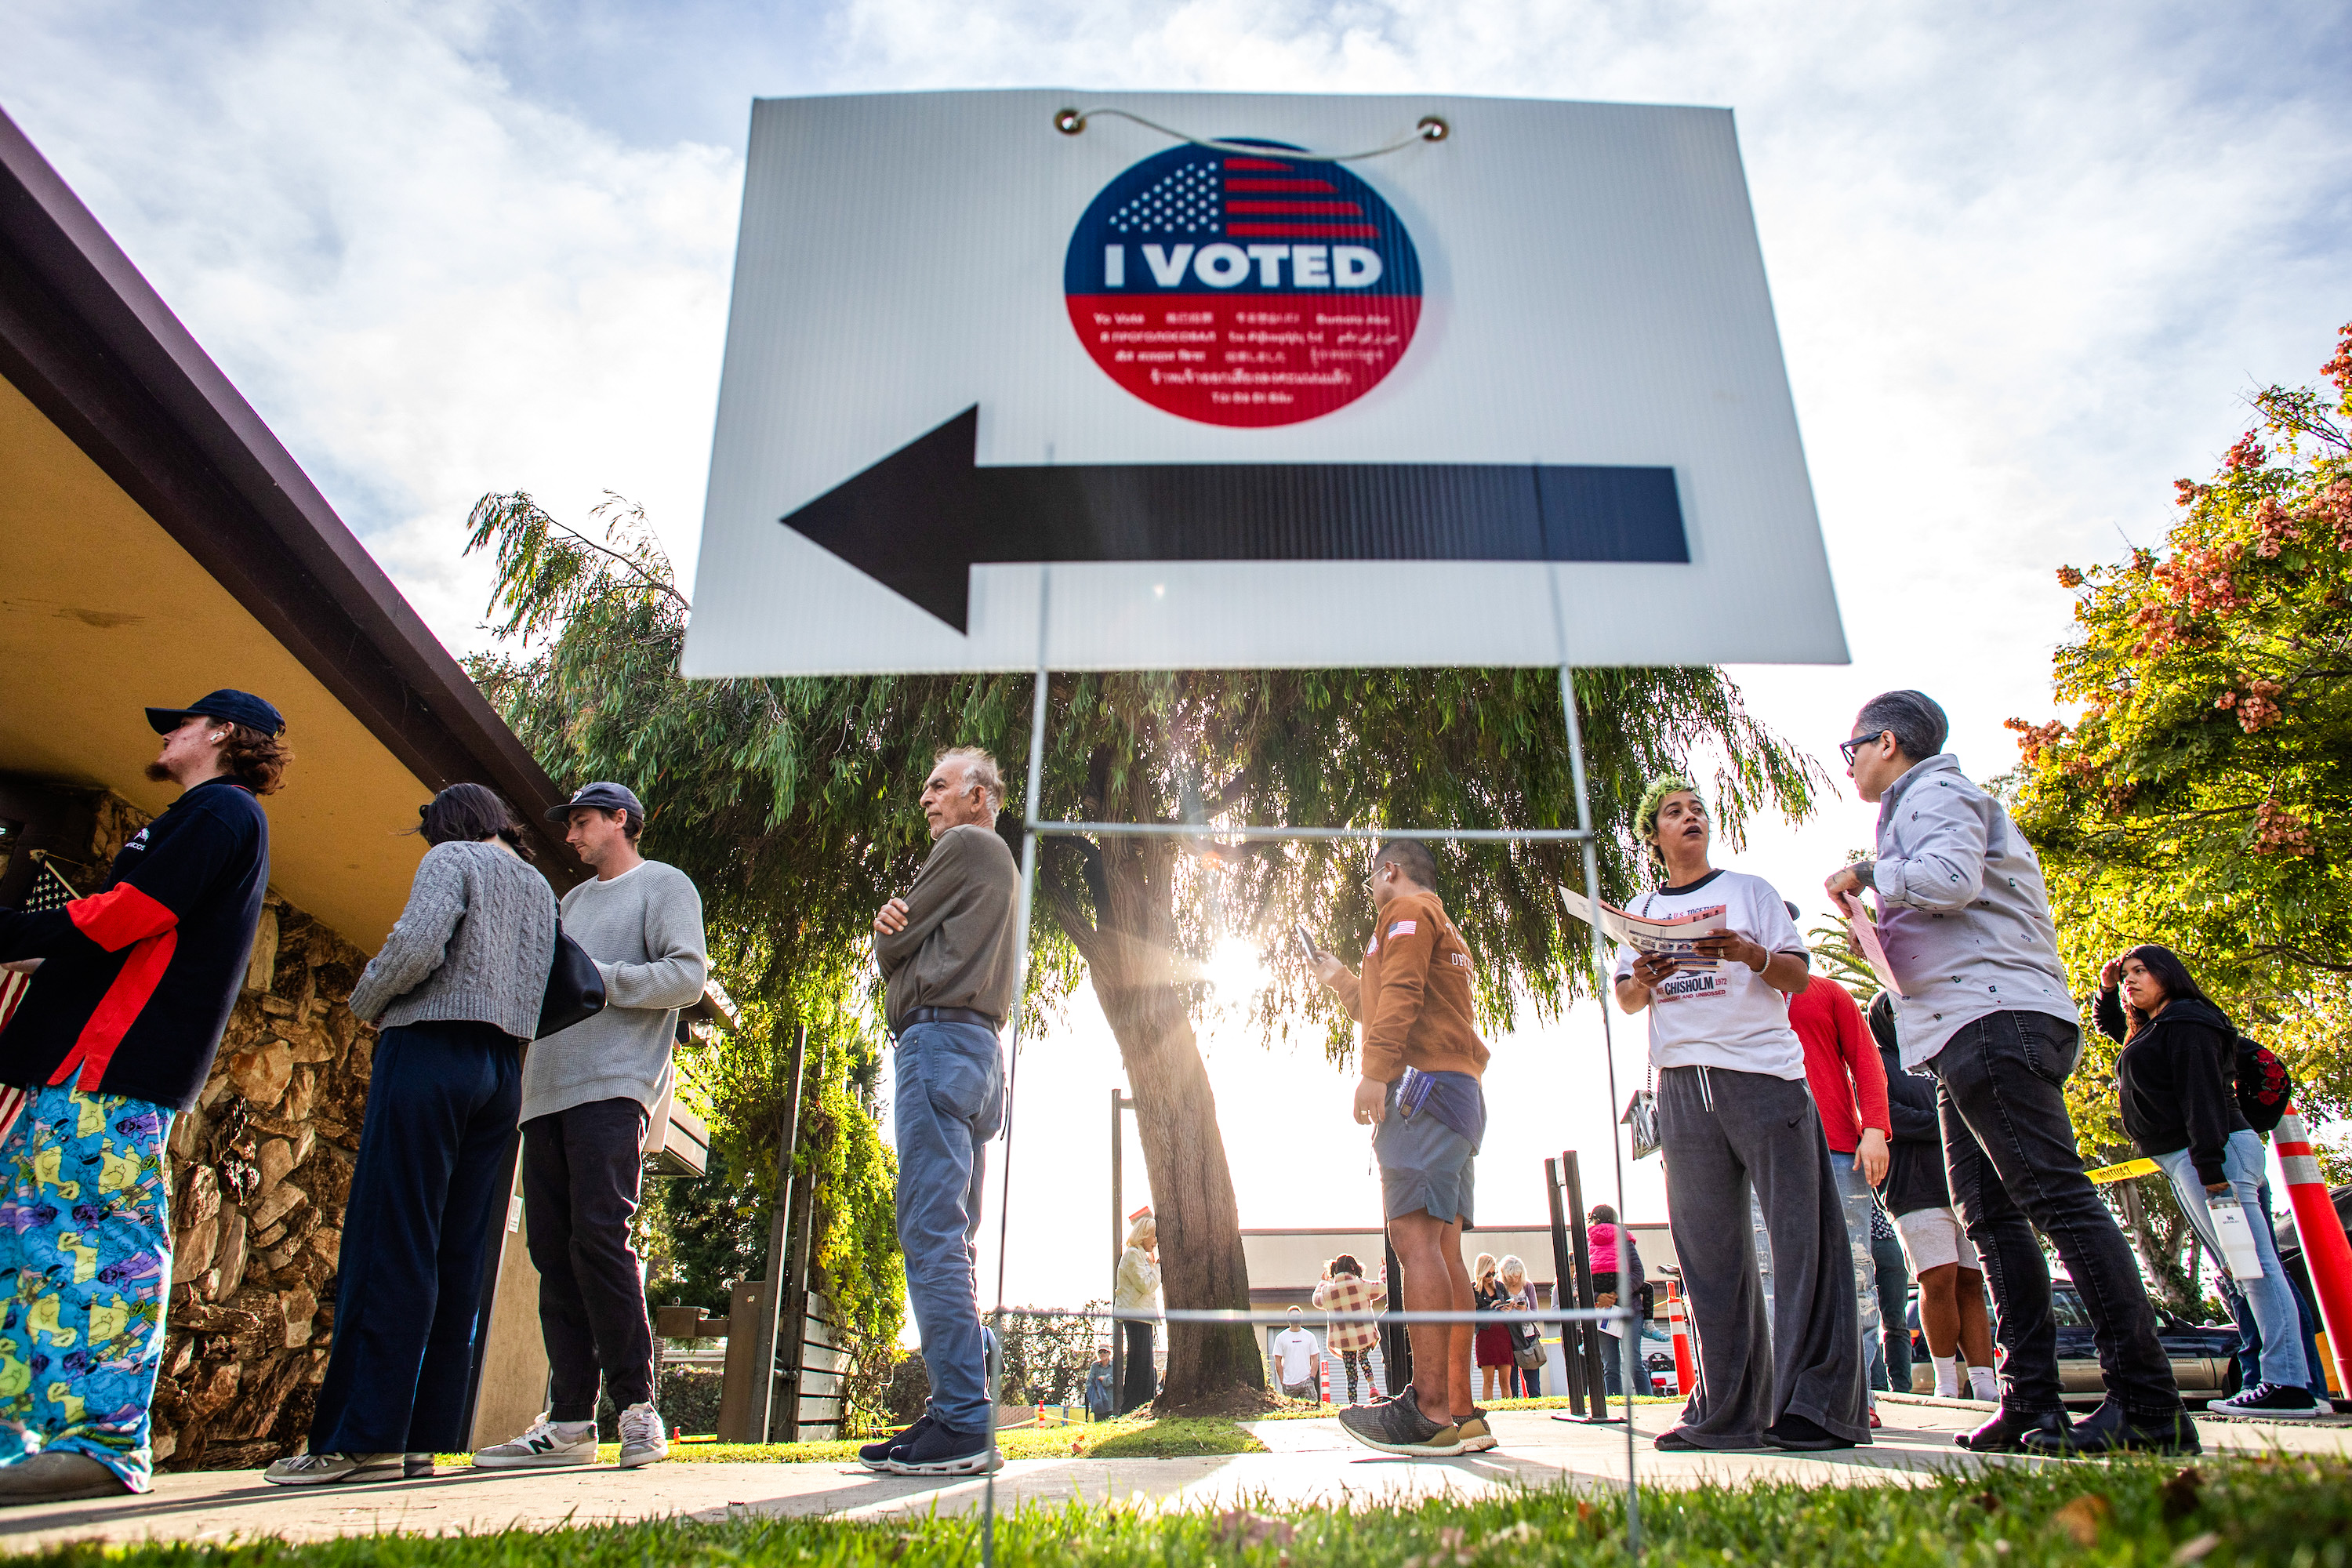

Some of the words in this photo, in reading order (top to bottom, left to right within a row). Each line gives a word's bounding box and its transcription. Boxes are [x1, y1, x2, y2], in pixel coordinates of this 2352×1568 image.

[1105, 244, 1124, 287] I
[1141, 242, 1383, 288] VOTED
[1664, 976, 1714, 996] CHISHOLM
[1715, 978, 1727, 986] 1972
[1695, 989, 1726, 998] UNBOSSED
[528, 1434, 555, 1455] N
